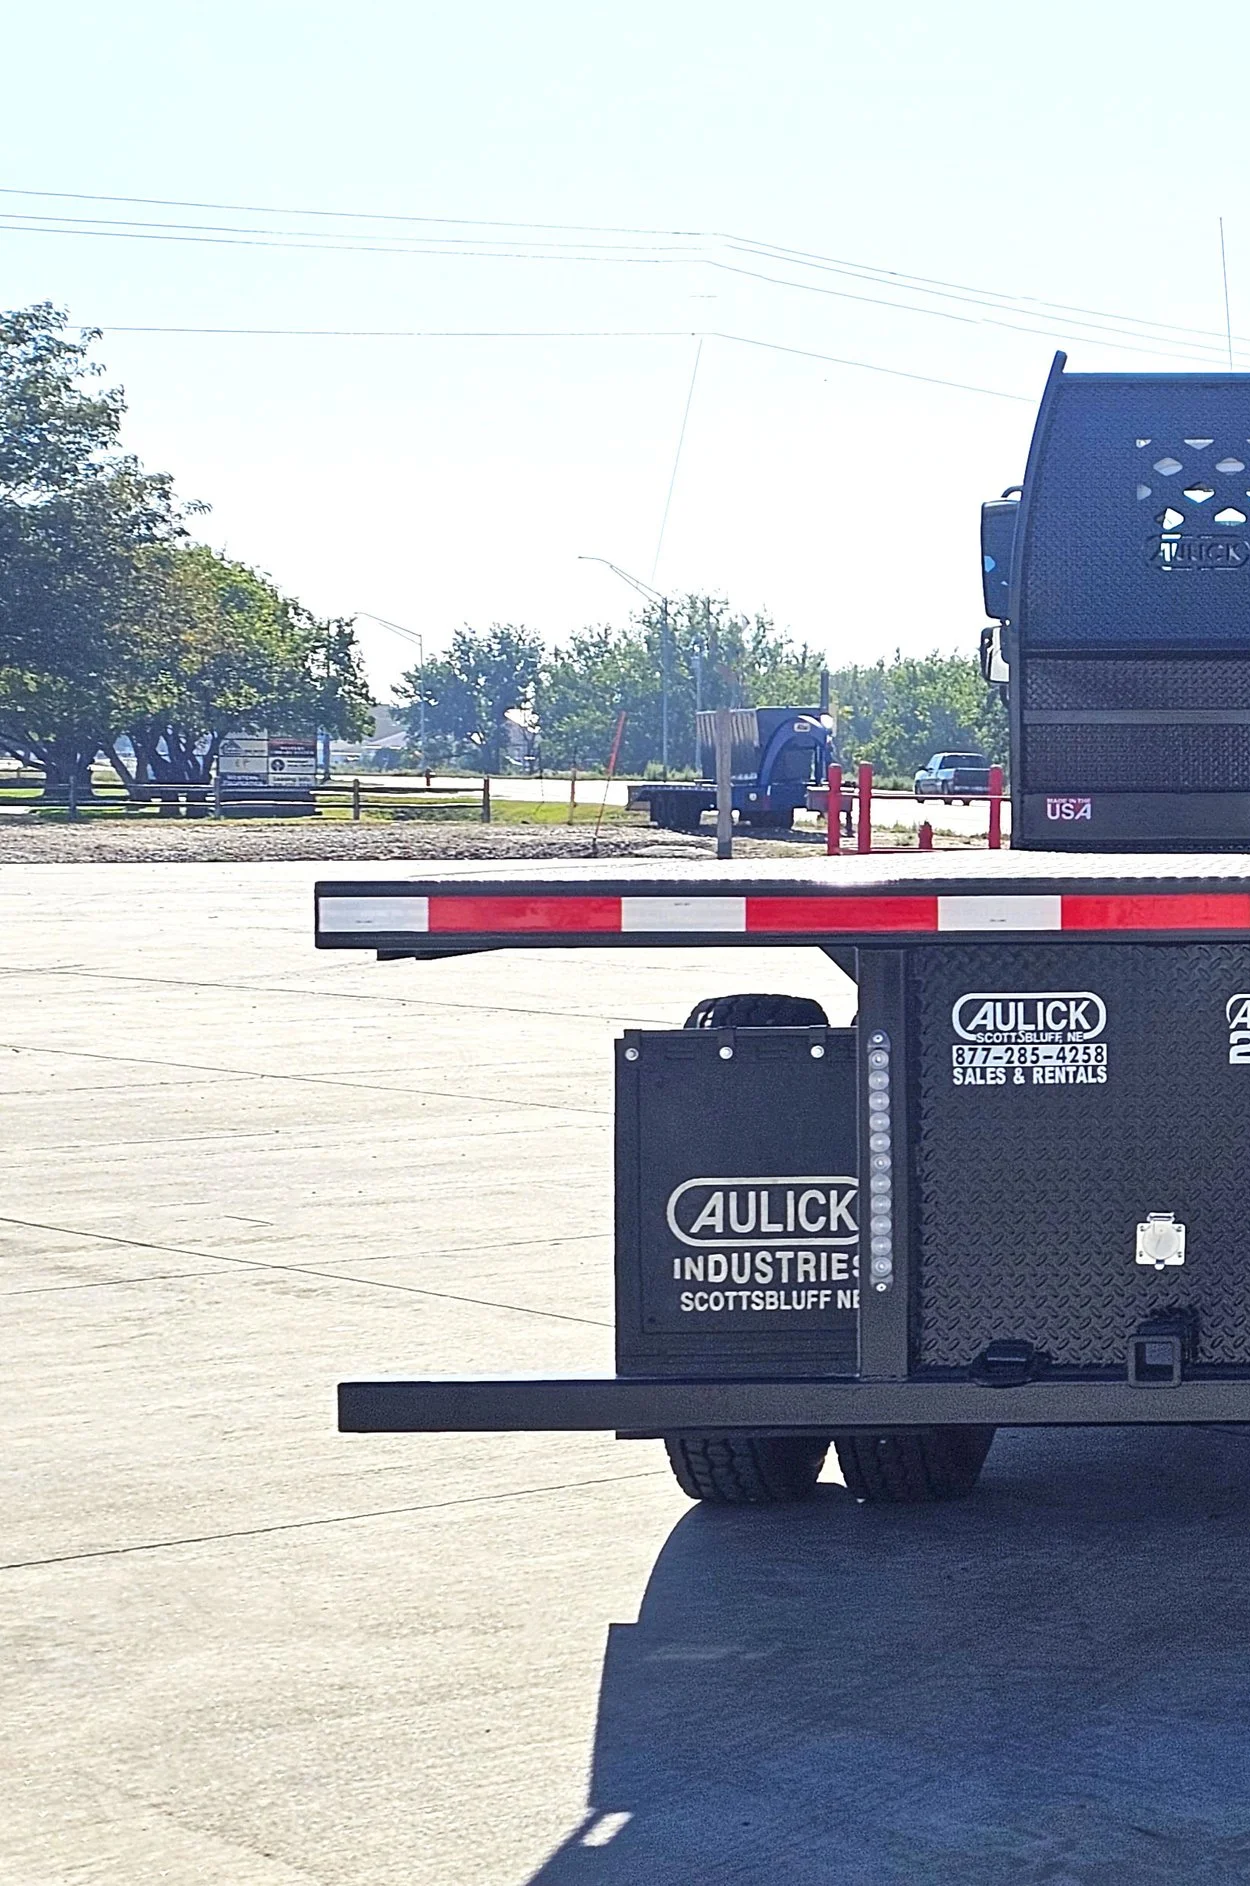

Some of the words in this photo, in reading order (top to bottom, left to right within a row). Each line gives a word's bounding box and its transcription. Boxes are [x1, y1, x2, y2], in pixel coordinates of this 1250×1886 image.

[1046, 803, 1092, 820] USA
[966, 1000, 1092, 1031] AULICK
[1067, 1031, 1084, 1042] NE
[955, 1045, 1105, 1065] 877-285-4258
[953, 1067, 1007, 1086] SALES
[1012, 1067, 1026, 1085] &
[1032, 1065, 1108, 1085] RENTALS
[689, 1189, 859, 1233] AULICK
[680, 1289, 832, 1312] SCOTTSBLUFF
